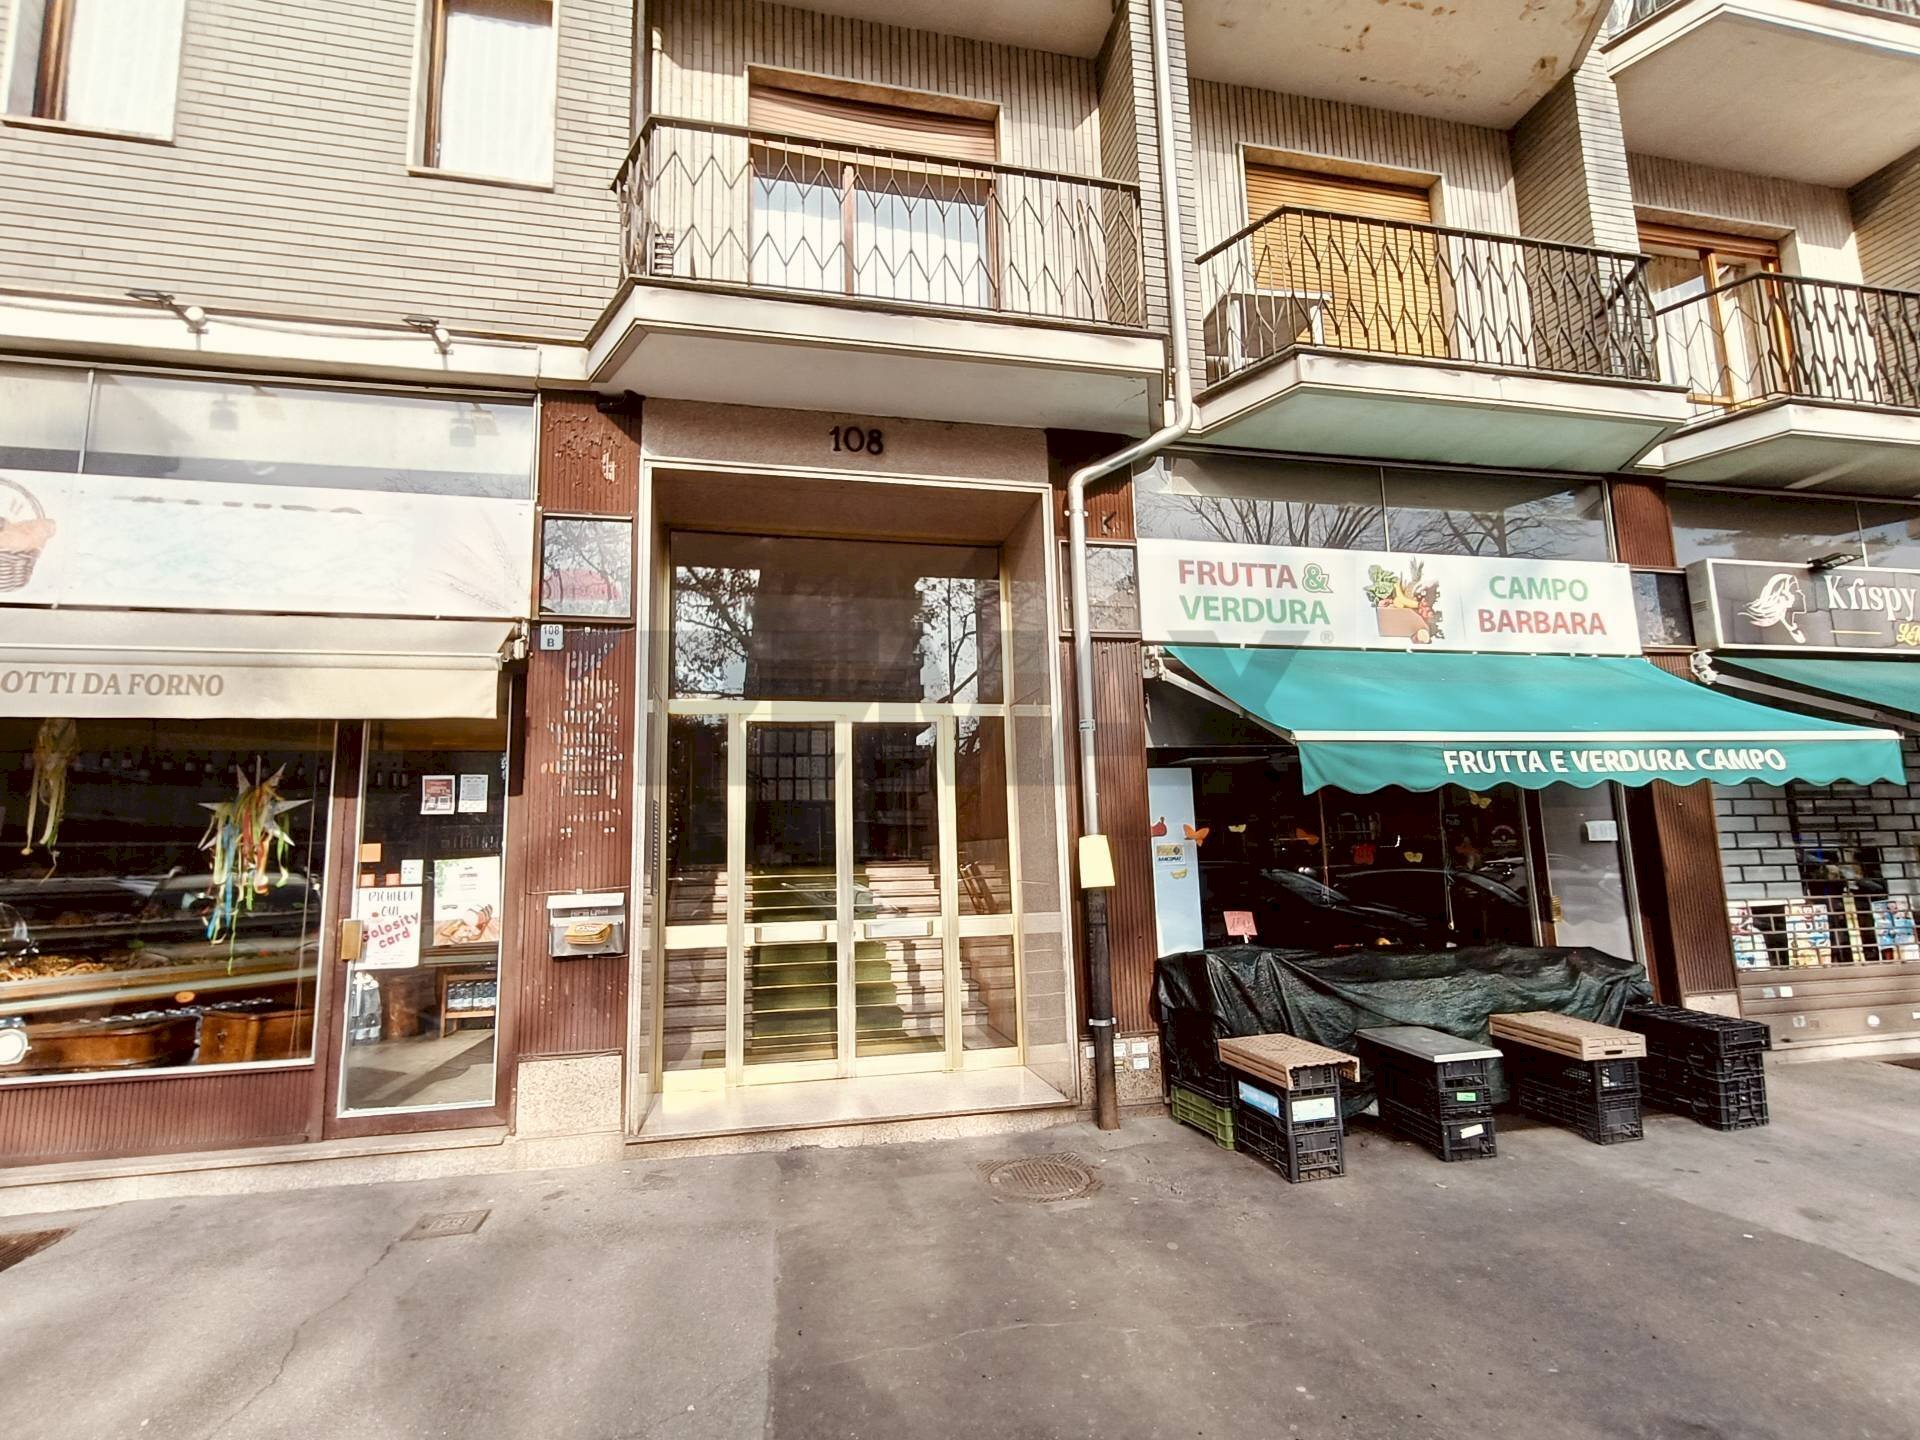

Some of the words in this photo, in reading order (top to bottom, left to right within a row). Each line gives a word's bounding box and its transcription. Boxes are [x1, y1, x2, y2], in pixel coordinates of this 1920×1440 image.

[829, 425, 884, 455] 108
[1178, 559, 1298, 589] FRUTTA
[1301, 562, 1334, 594] &
[1488, 575, 1589, 601] CAMPO
[1178, 595, 1331, 625] VERDURA
[1823, 574, 1918, 622] Krispy
[542, 625, 560, 636] 108
[1477, 608, 1607, 636] BARBARA
[546, 638, 555, 648] B
[81, 672, 122, 696] DA
[128, 673, 225, 697] FORNO
[1443, 749, 1549, 775] FRUTTA
[1550, 750, 1569, 774] E
[1569, 749, 1696, 774] VERDURA
[1696, 748, 1787, 772] CAMPO
[378, 926, 411, 949] card
